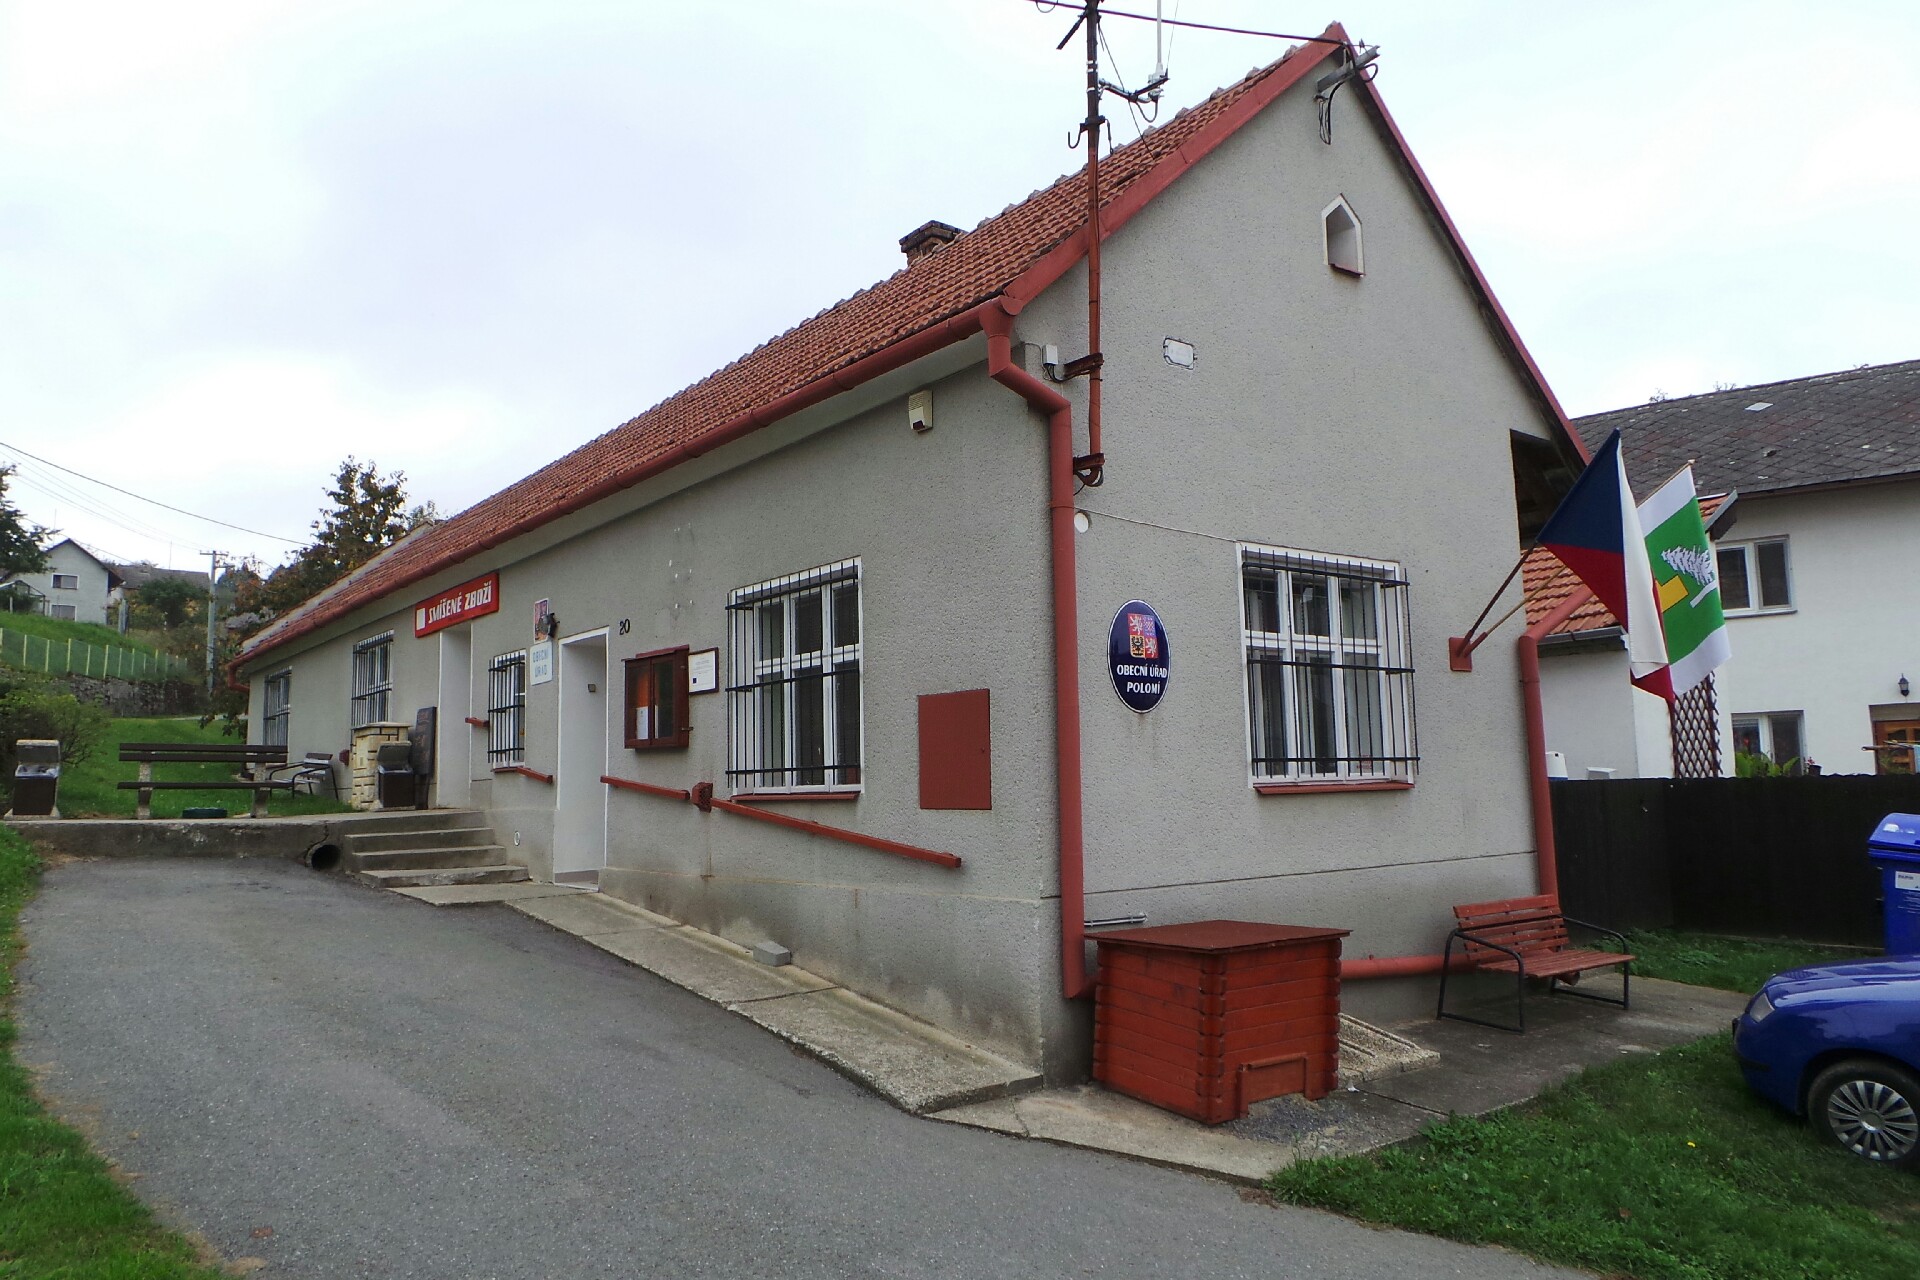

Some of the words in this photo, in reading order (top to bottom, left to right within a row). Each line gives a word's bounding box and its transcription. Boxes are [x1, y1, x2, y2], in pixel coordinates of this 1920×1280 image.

[428, 592, 462, 624] SMÍŠENÉ
[464, 581, 492, 611] ZBOŽÍ
[619, 618, 631, 636] 20
[1116, 663, 1148, 677] OBECNÍ
[1149, 664, 1168, 679] ÚŘAD
[1126, 681, 1161, 695] POLOMÍ
